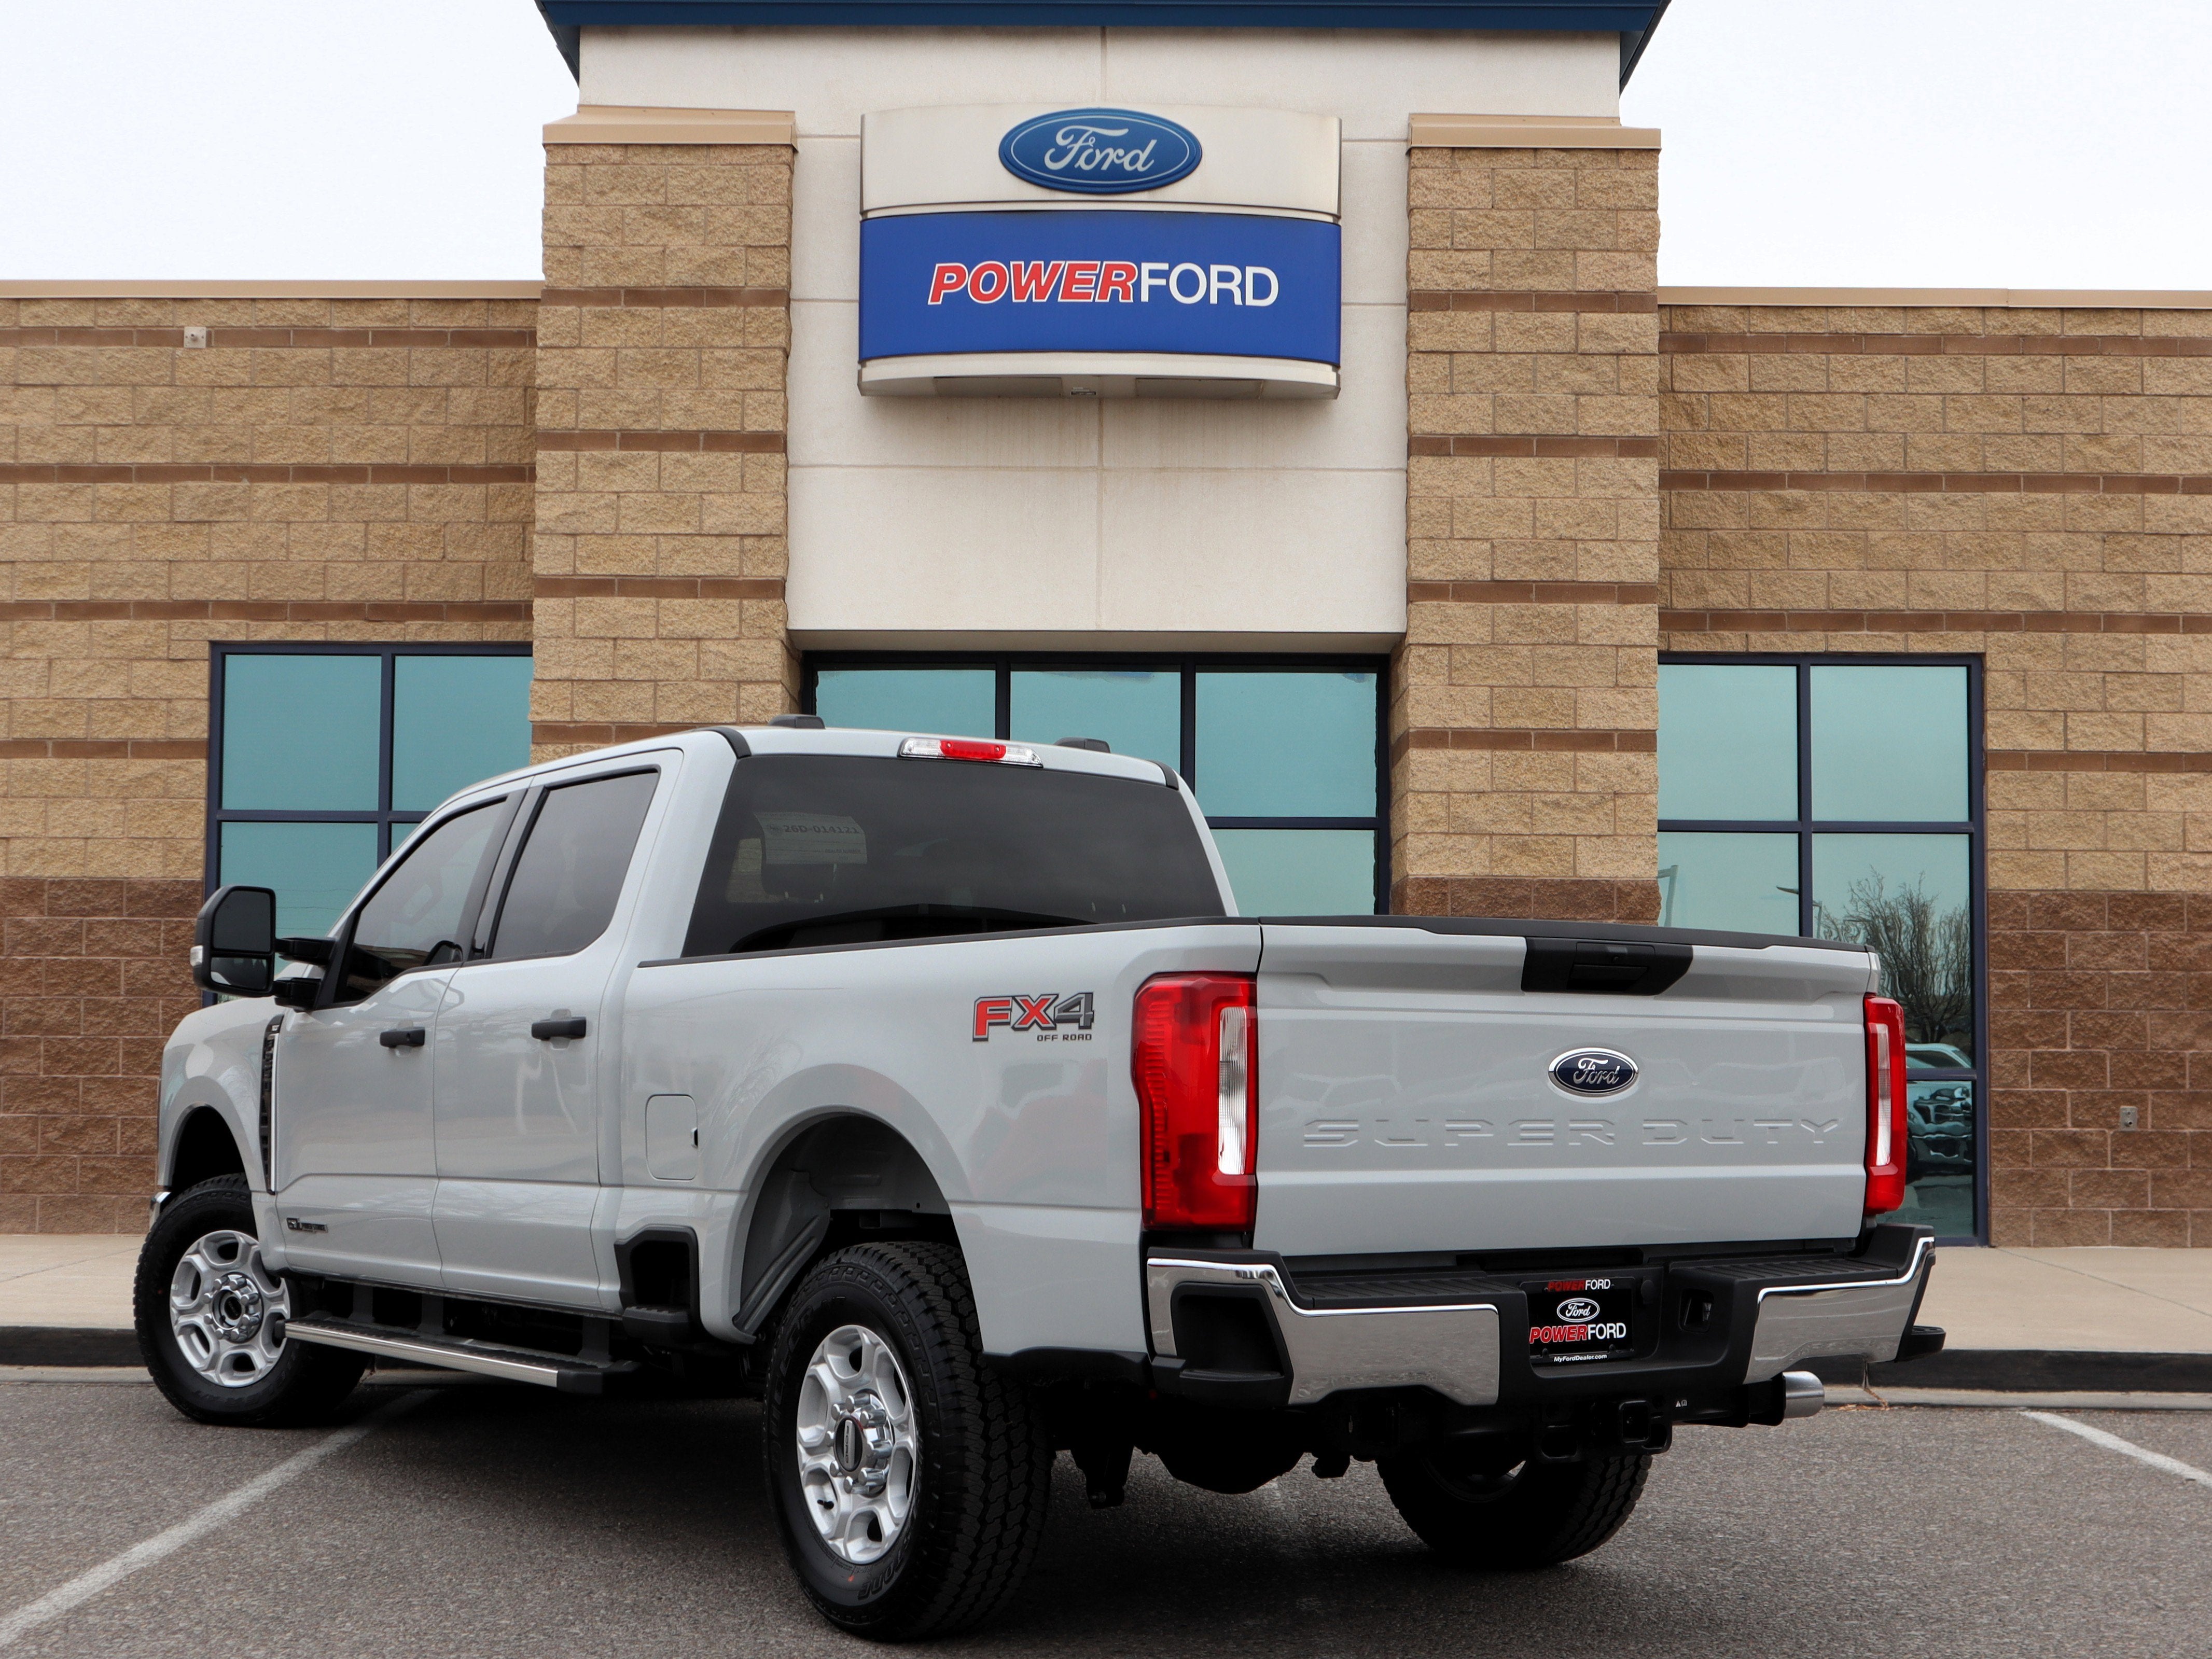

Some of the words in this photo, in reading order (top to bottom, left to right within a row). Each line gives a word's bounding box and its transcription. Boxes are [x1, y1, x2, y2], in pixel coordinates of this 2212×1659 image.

[1044, 124, 1158, 172] Ford
[927, 260, 1279, 306] POWERFORD
[972, 992, 1094, 1042] FX4
[1573, 1057, 1621, 1085] Ford
[1303, 1119, 1615, 1147] SUPER
[1642, 1118, 1839, 1147] DUTY
[1547, 1278, 1611, 1292] POWERFORD
[1565, 1302, 1591, 1317] Ford
[1529, 1322, 1626, 1344] POWERFORD
[1553, 1354, 1607, 1363] MyFordDealer.com
